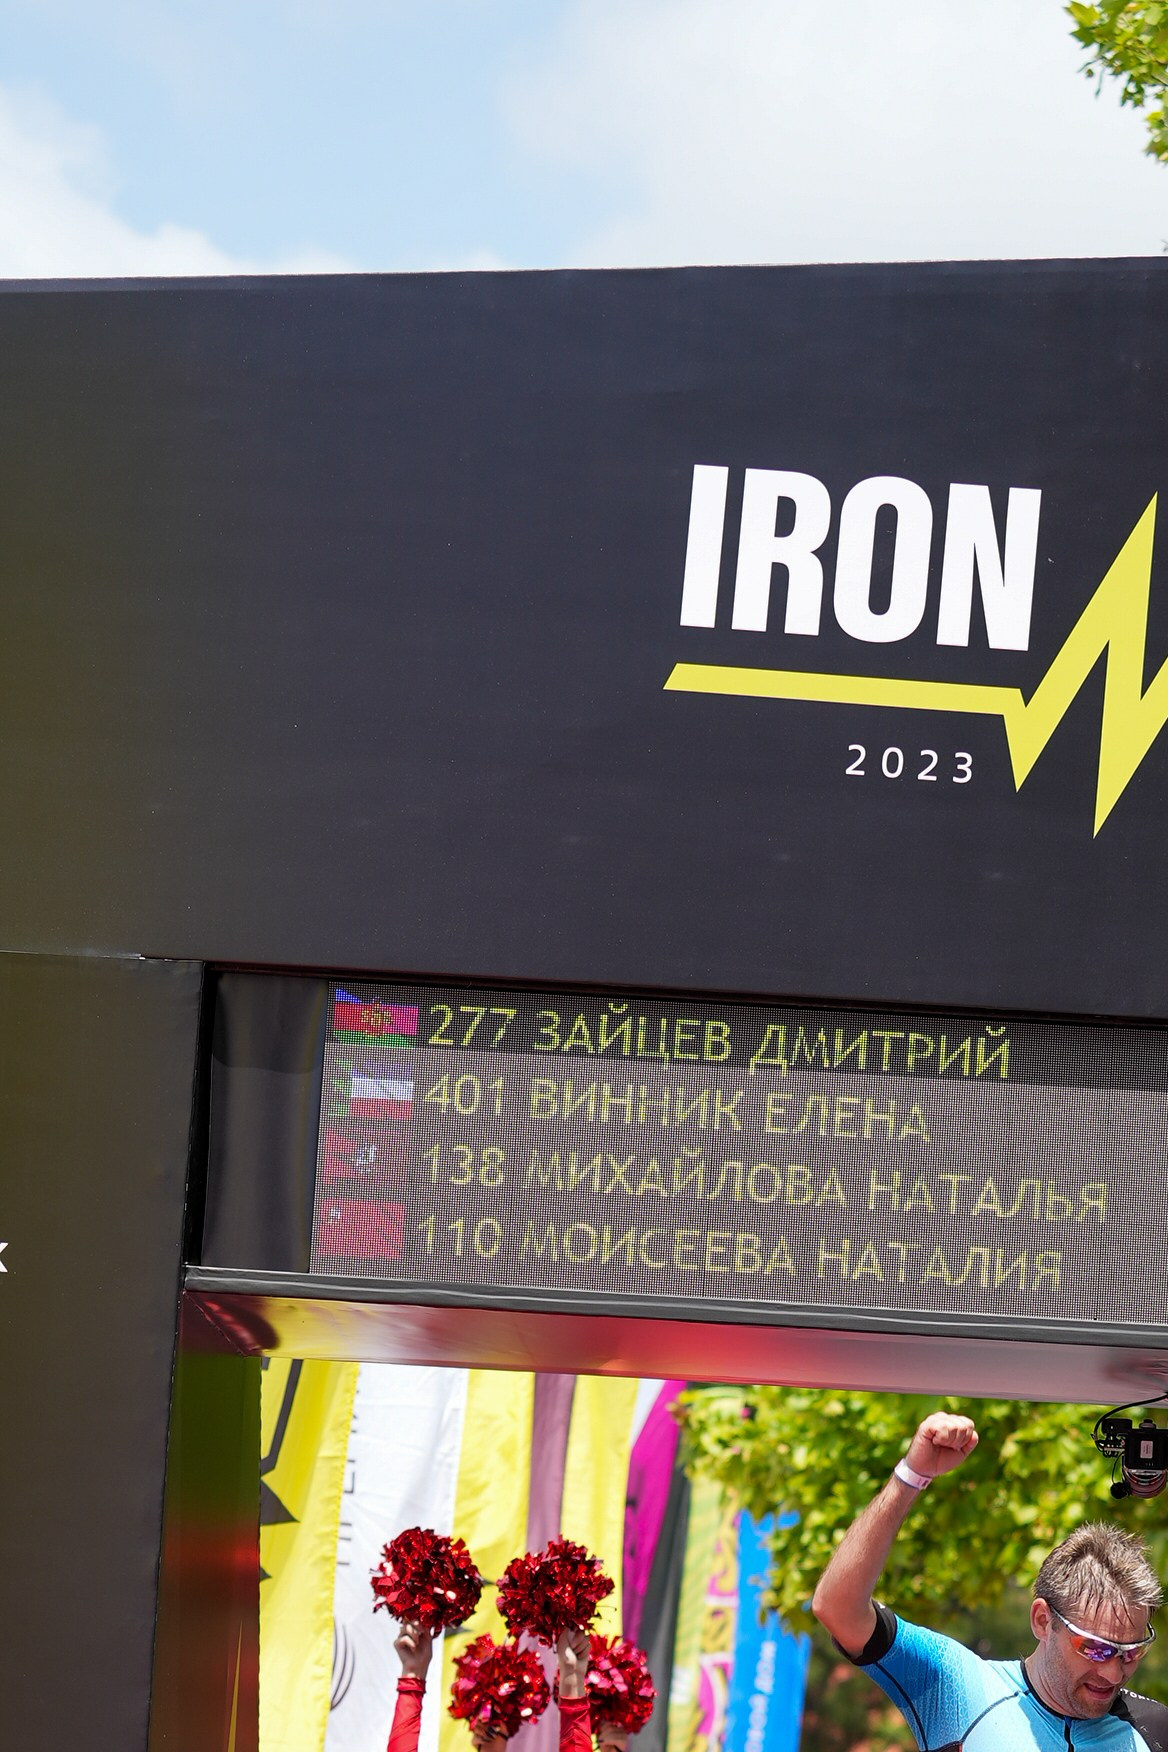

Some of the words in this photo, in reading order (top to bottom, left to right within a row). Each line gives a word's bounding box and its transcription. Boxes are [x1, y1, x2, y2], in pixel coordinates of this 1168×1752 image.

[677, 463, 1043, 652] IRON
[844, 742, 977, 785] 2023
[427, 1003, 518, 1050] 277
[533, 1002, 732, 1066] ЗАЙЦЕВ
[748, 1020, 1012, 1080] ДМИТРИЙ
[423, 1073, 506, 1119] 401
[529, 1077, 744, 1135] ВИННИК
[764, 1092, 932, 1145] ЕЛЕНА
[421, 1145, 506, 1191] 138
[525, 1147, 848, 1212] МИХАЙЛОВА
[867, 1169, 1109, 1224] НАТАЛЬЯ
[415, 1215, 503, 1261] 110
[522, 1220, 797, 1279] МОИСЕЕВА
[817, 1238, 1064, 1293] НАТАЛИЯ
